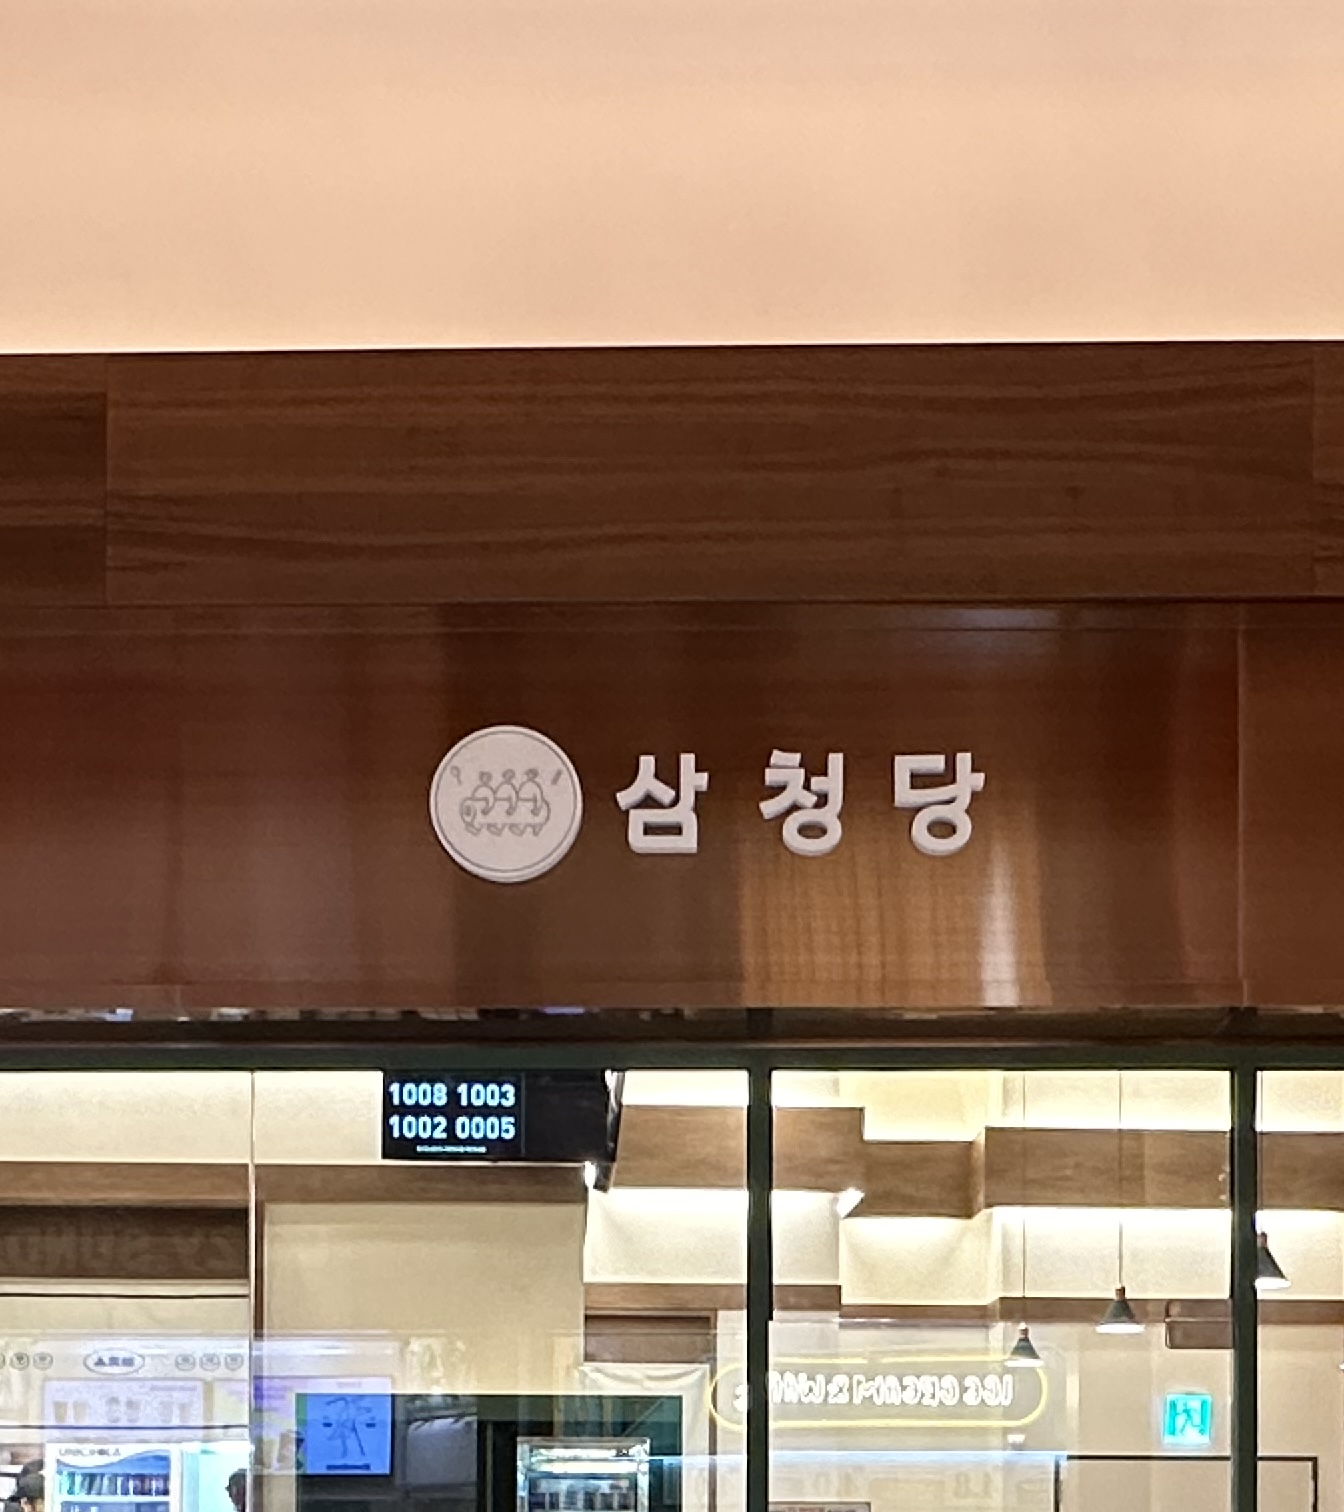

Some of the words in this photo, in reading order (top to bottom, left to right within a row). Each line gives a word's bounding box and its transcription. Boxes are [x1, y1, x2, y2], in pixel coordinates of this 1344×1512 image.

[616, 749, 986, 856] 삼청당
[389, 1082, 448, 1107] 1008
[457, 1082, 516, 1107] 1003
[389, 1115, 448, 1140] 1002
[455, 1115, 516, 1140] 0005
